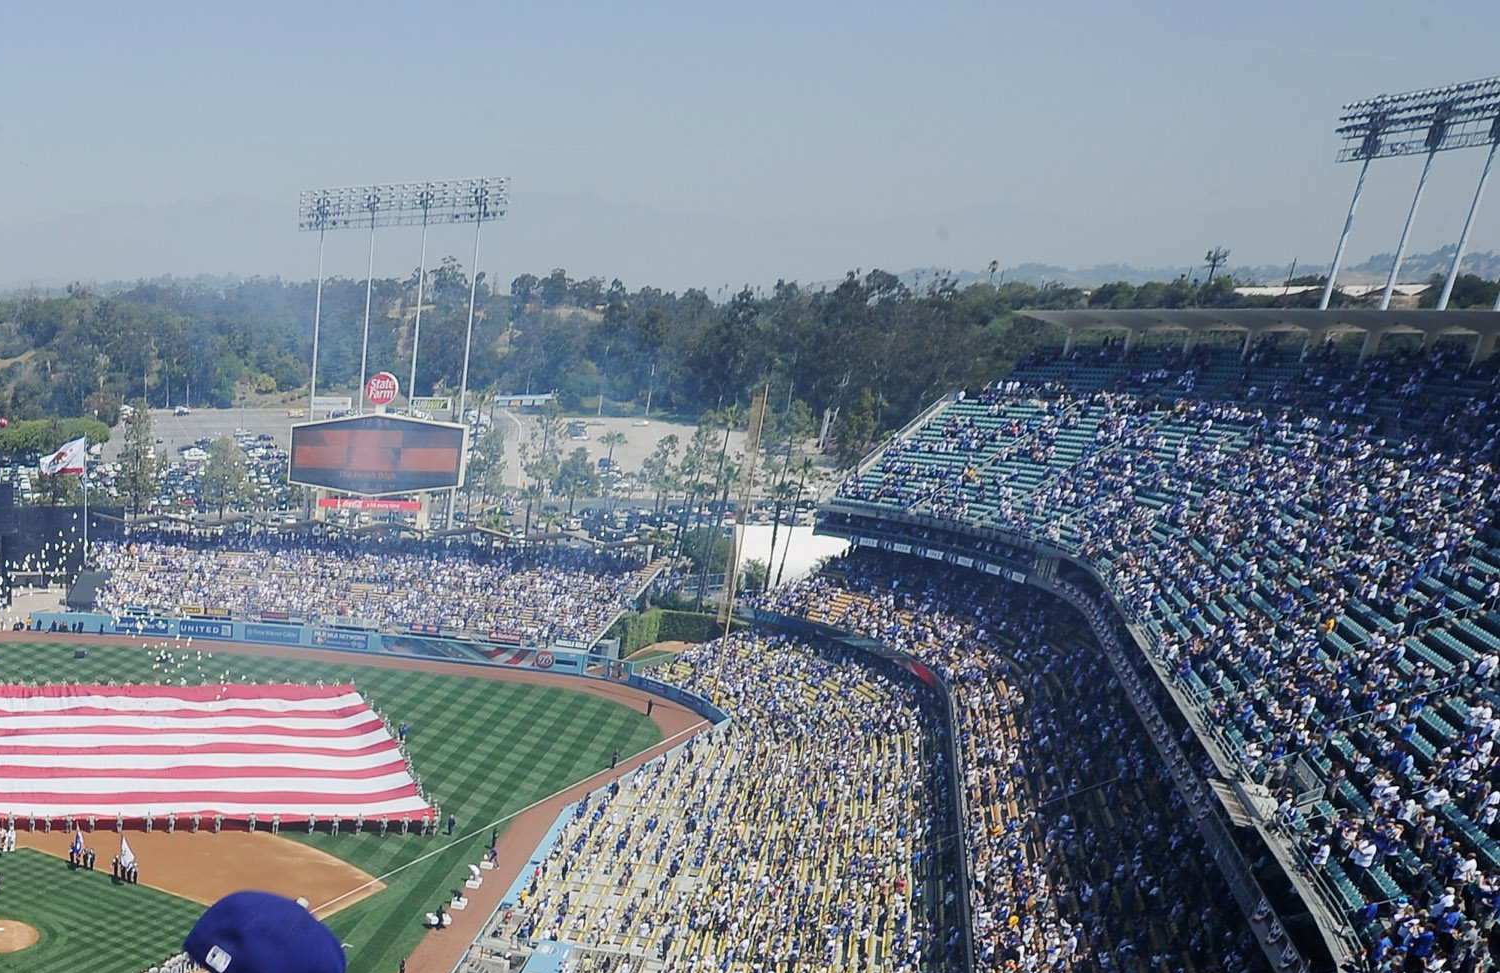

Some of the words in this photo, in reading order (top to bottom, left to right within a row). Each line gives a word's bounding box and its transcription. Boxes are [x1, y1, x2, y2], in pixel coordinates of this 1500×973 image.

[370, 378, 395, 391] State
[369, 389, 394, 400] Farm
[412, 399, 447, 409] SUBWAY
[180, 625, 220, 634] UNITED
[340, 633, 367, 641] NETWORK
[537, 656, 553, 665] 76
